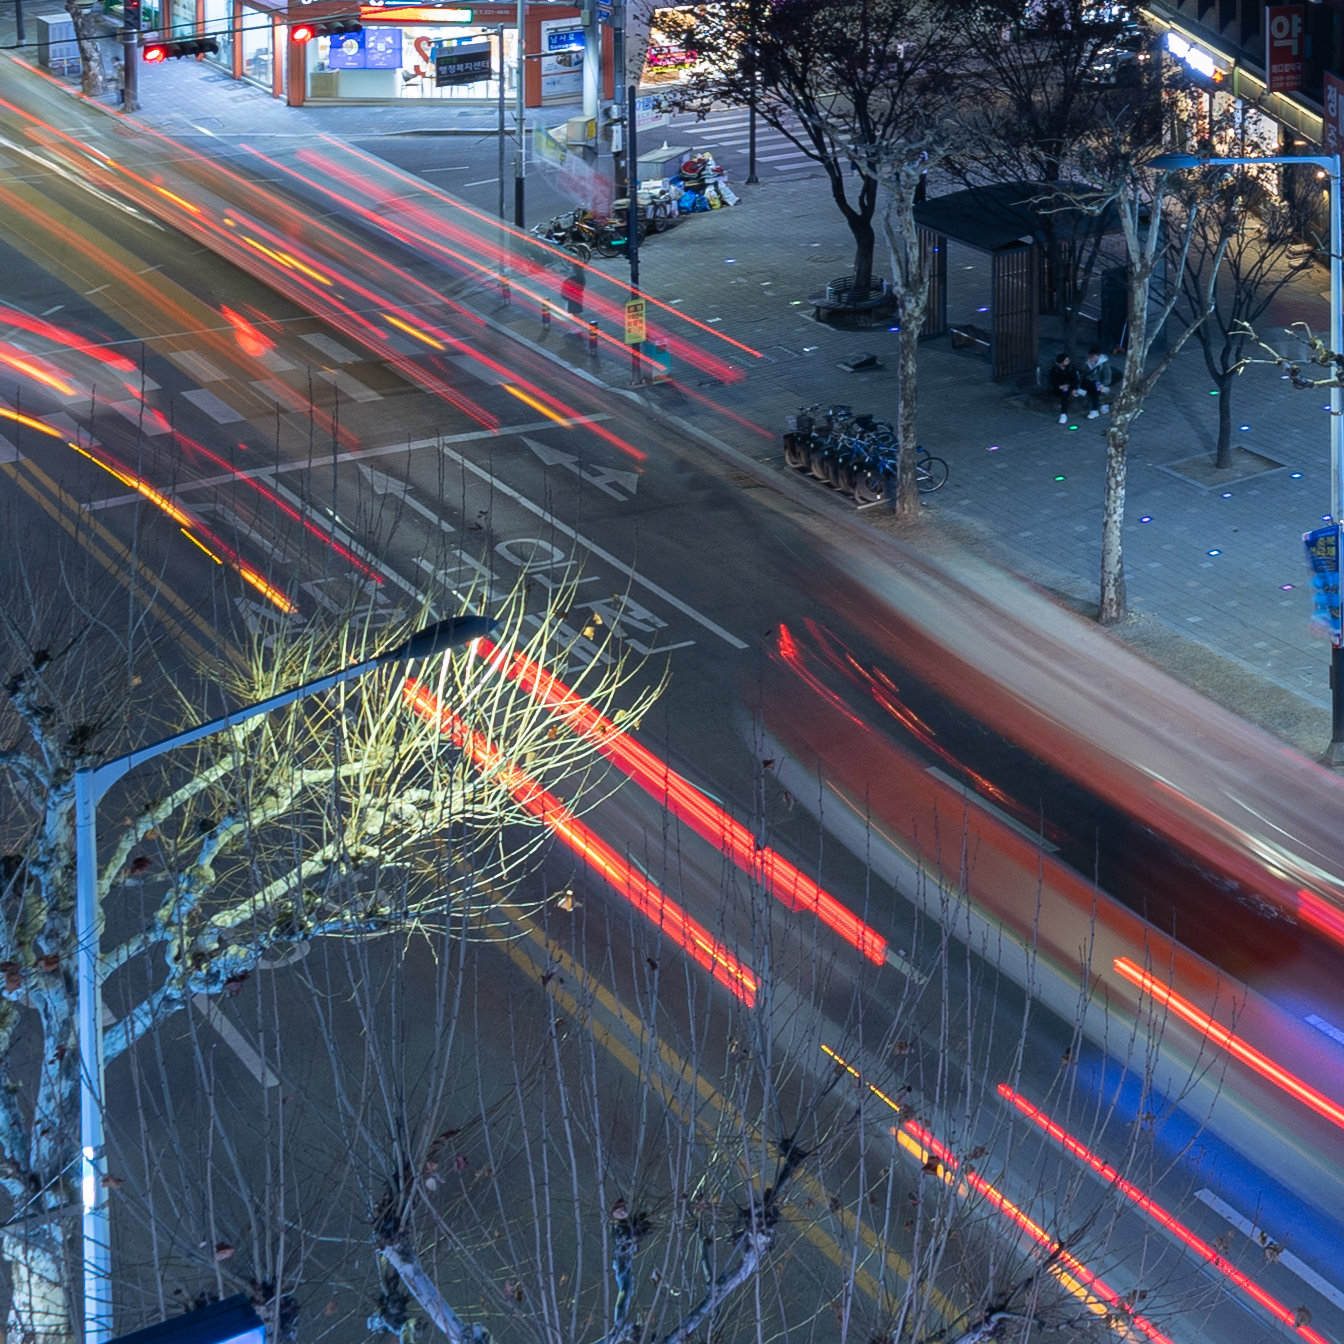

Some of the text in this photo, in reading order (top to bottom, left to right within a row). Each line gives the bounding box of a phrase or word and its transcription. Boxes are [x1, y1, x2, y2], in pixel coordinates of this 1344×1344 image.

[550, 33, 575, 44] 남사로
[1271, 12, 1302, 56] 약
[1271, 62, 1302, 74] 메디칼약국
[1326, 84, 1339, 150] 청주
